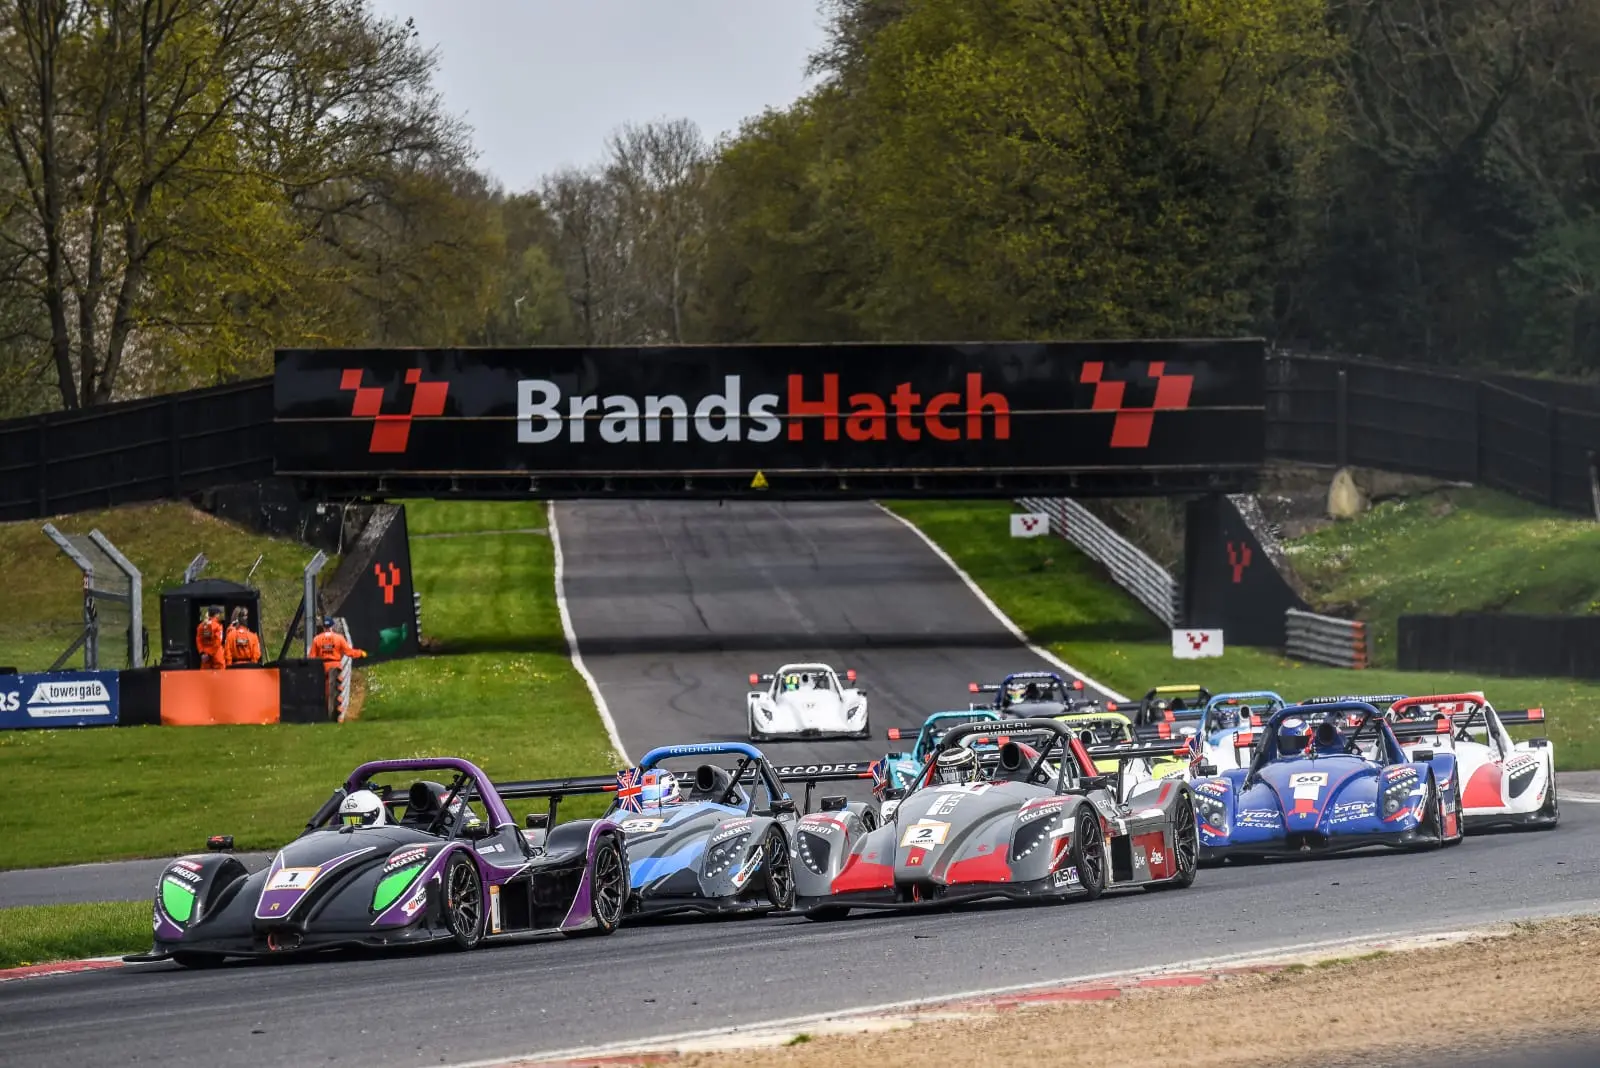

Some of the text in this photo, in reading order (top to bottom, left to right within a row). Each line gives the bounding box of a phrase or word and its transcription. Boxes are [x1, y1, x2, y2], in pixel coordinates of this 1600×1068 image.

[50, 684, 101, 700] towergate
[973, 722, 1031, 731] RADICAL
[670, 745, 725, 754] RADICAL
[1296, 775, 1323, 783] 60
[1020, 806, 1062, 822] HAGERTY
[712, 825, 751, 841] HAGERTY
[797, 824, 832, 835] HAGERTY
[917, 828, 933, 839] 2
[383, 852, 426, 873] HAGERTY
[171, 866, 202, 883] HAGERTY
[289, 872, 299, 882] 1
